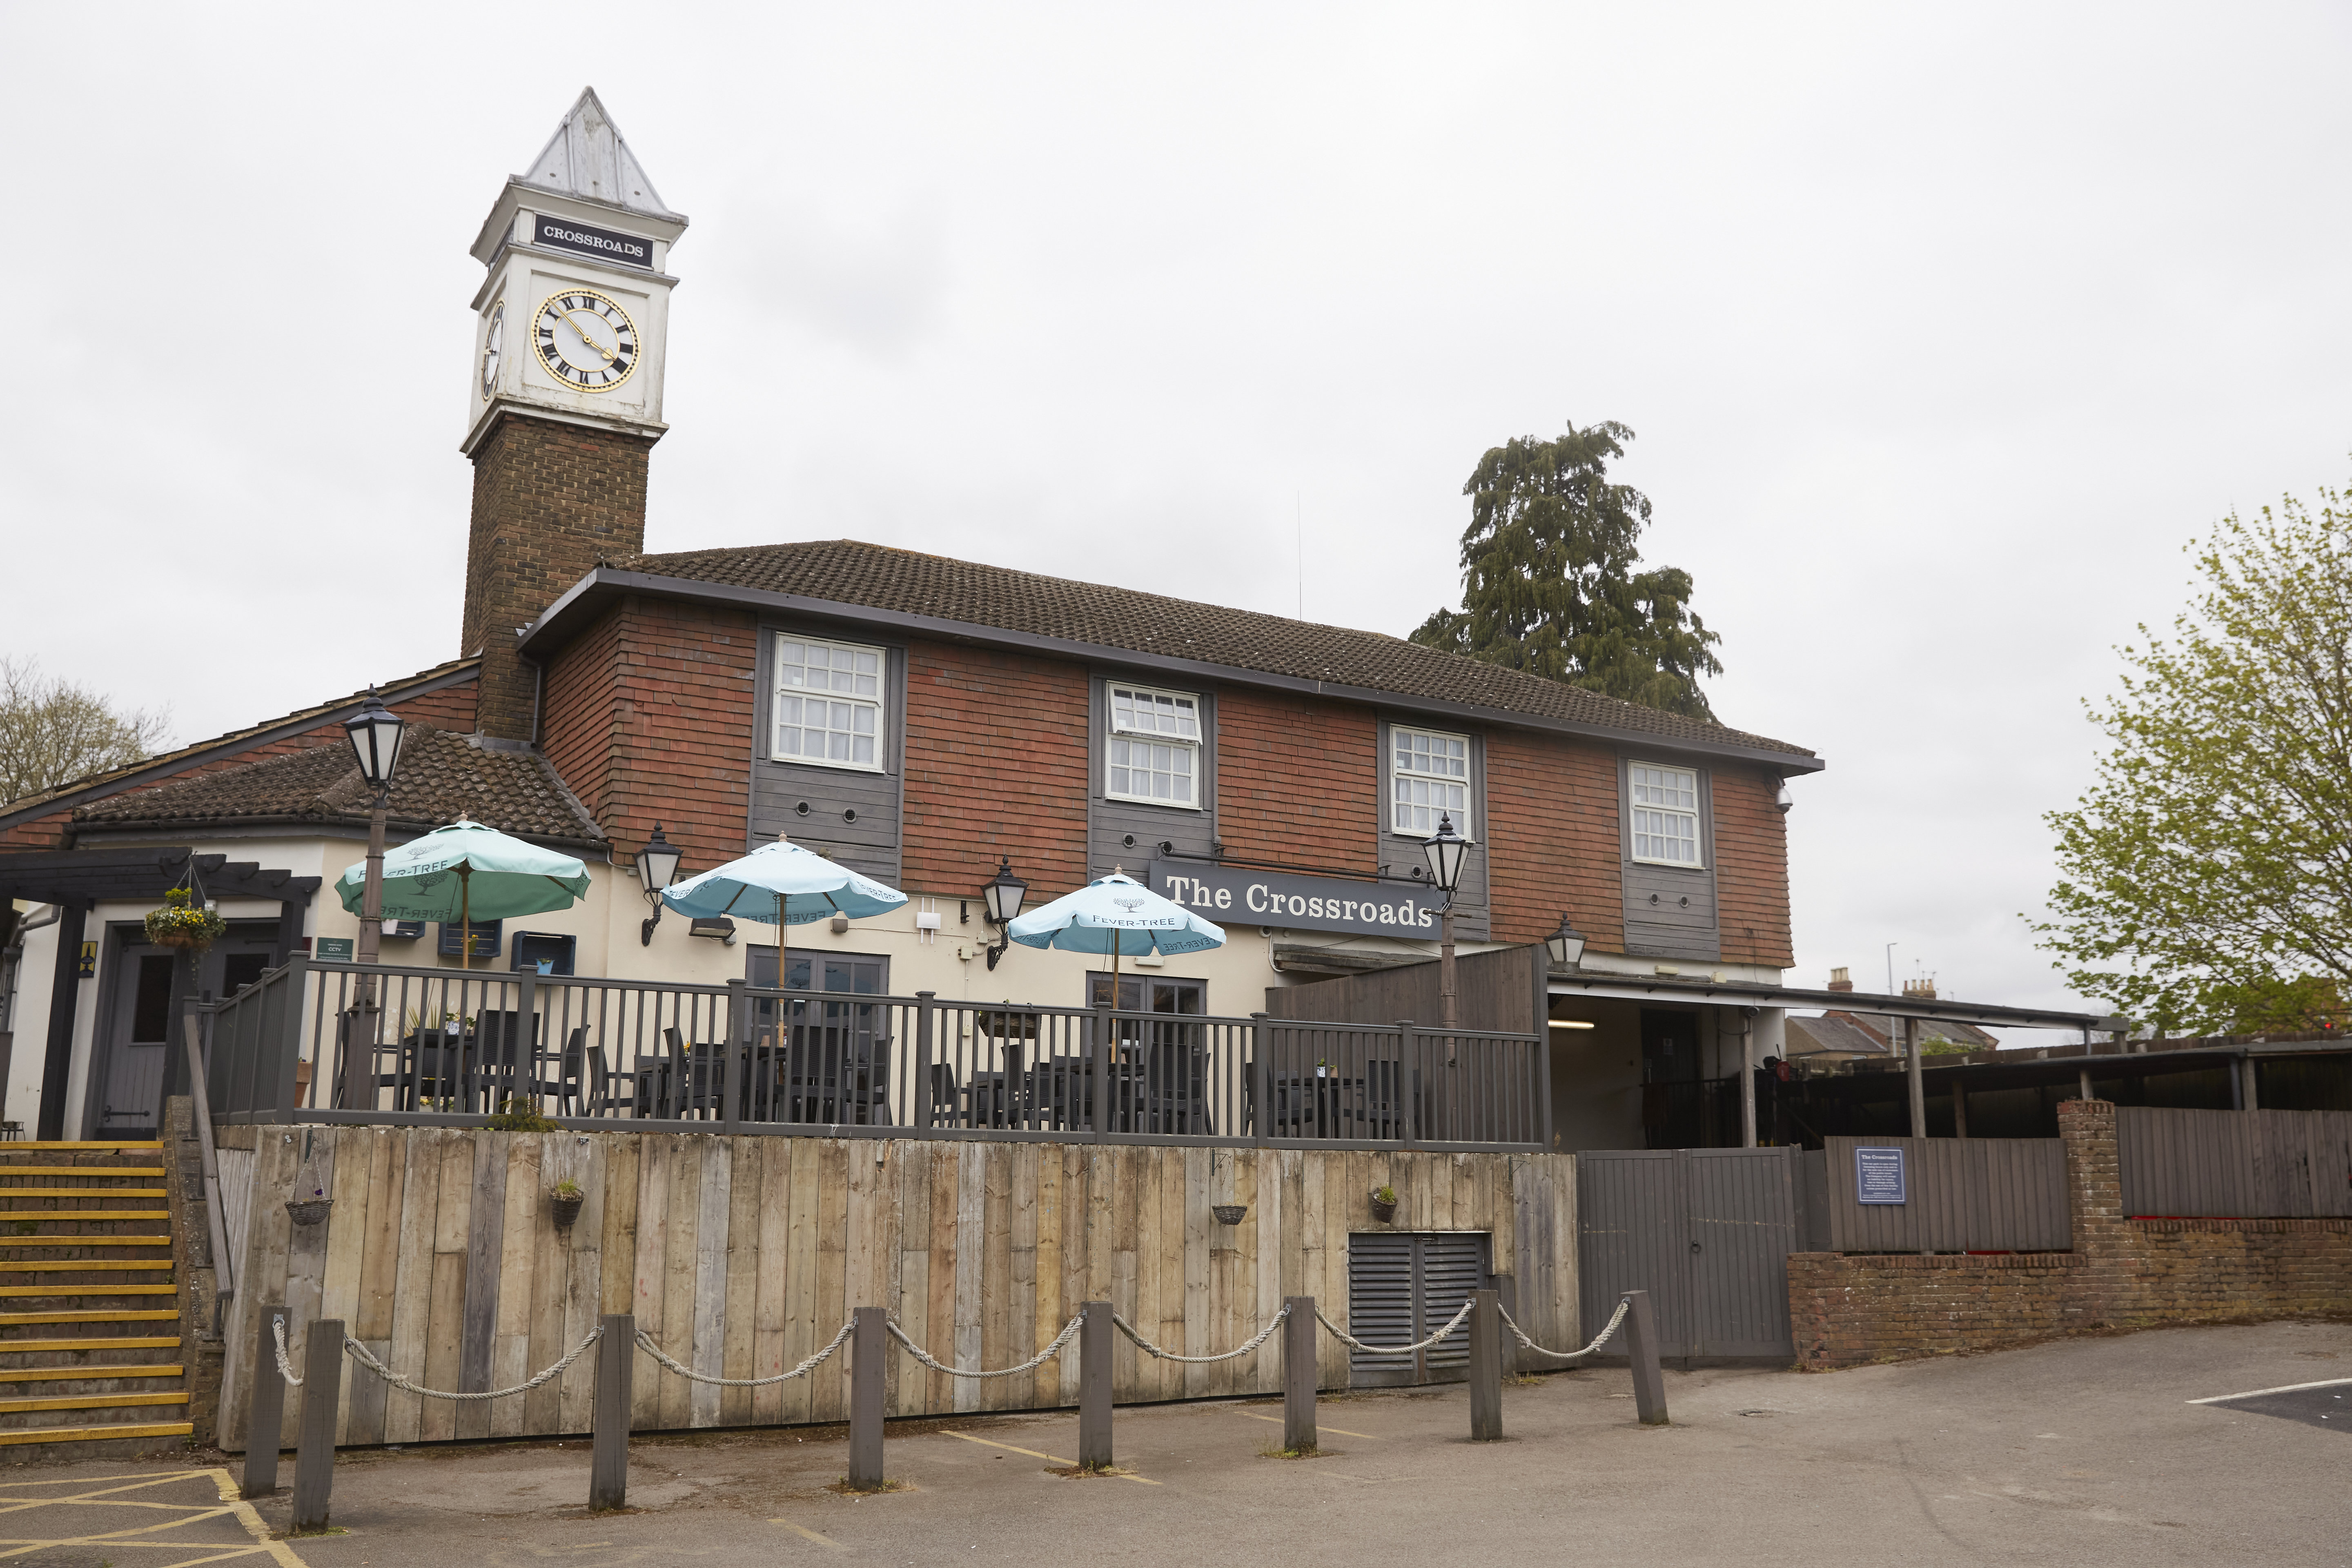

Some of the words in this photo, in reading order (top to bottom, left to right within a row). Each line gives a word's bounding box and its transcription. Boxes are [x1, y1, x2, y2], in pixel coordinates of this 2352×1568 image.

[543, 225, 644, 257] CROSSROADS
[358, 860, 448, 878] FER-TREE
[1167, 875, 1232, 909] The
[1246, 884, 1432, 928] Crossroads
[1093, 915, 1175, 927] FEVER-TREE
